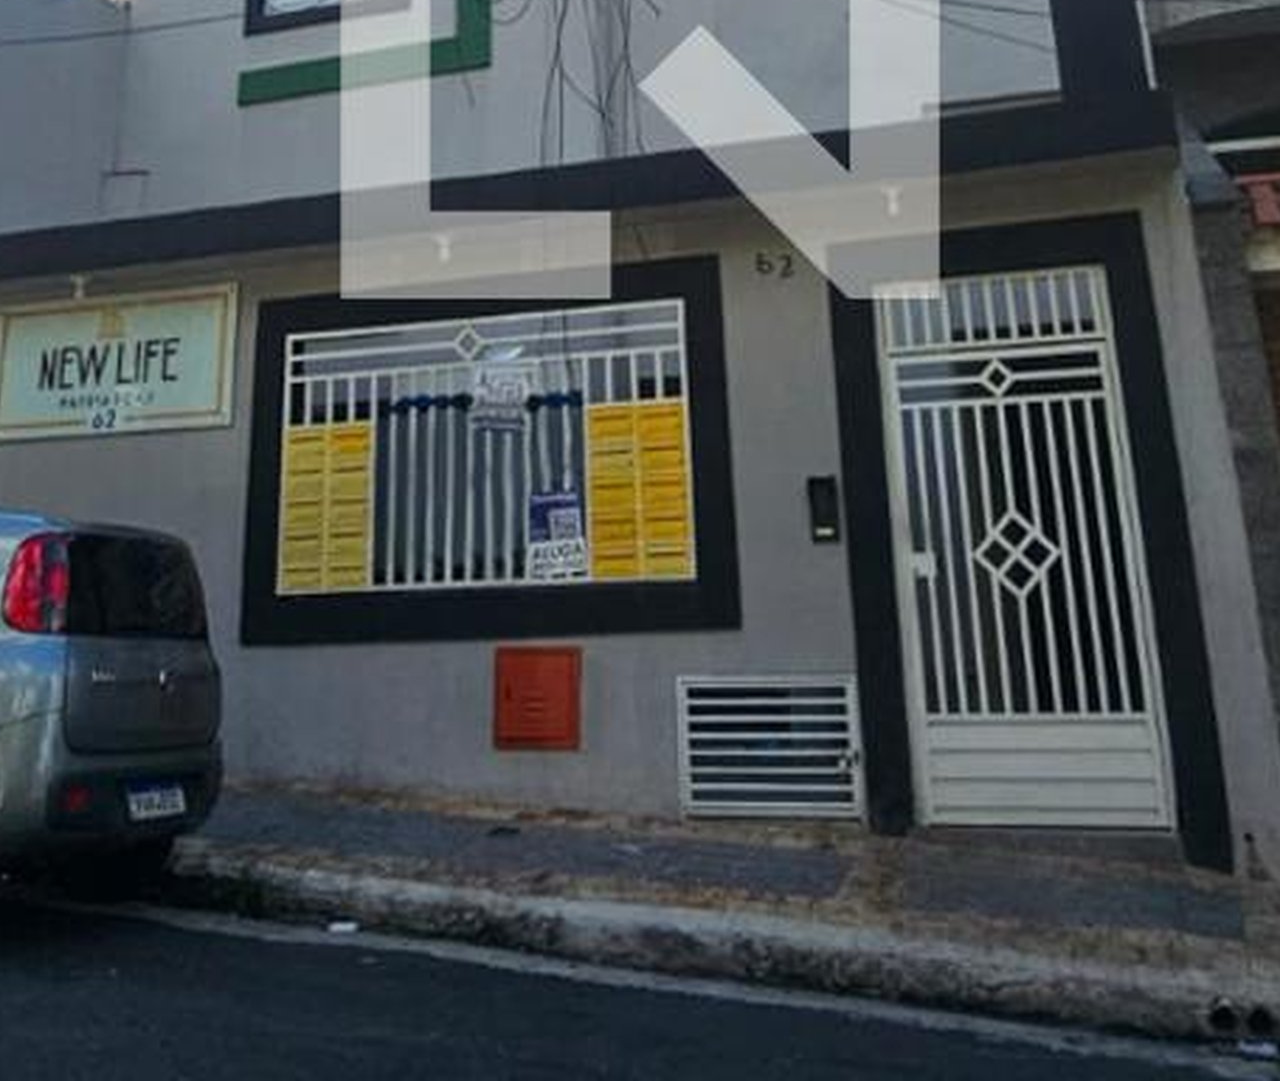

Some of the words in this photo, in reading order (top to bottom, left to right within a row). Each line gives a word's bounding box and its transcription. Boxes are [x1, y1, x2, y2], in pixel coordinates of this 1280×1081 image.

[37, 344, 110, 391] NEW
[116, 337, 180, 385] LIFE
[92, 408, 117, 429] 62
